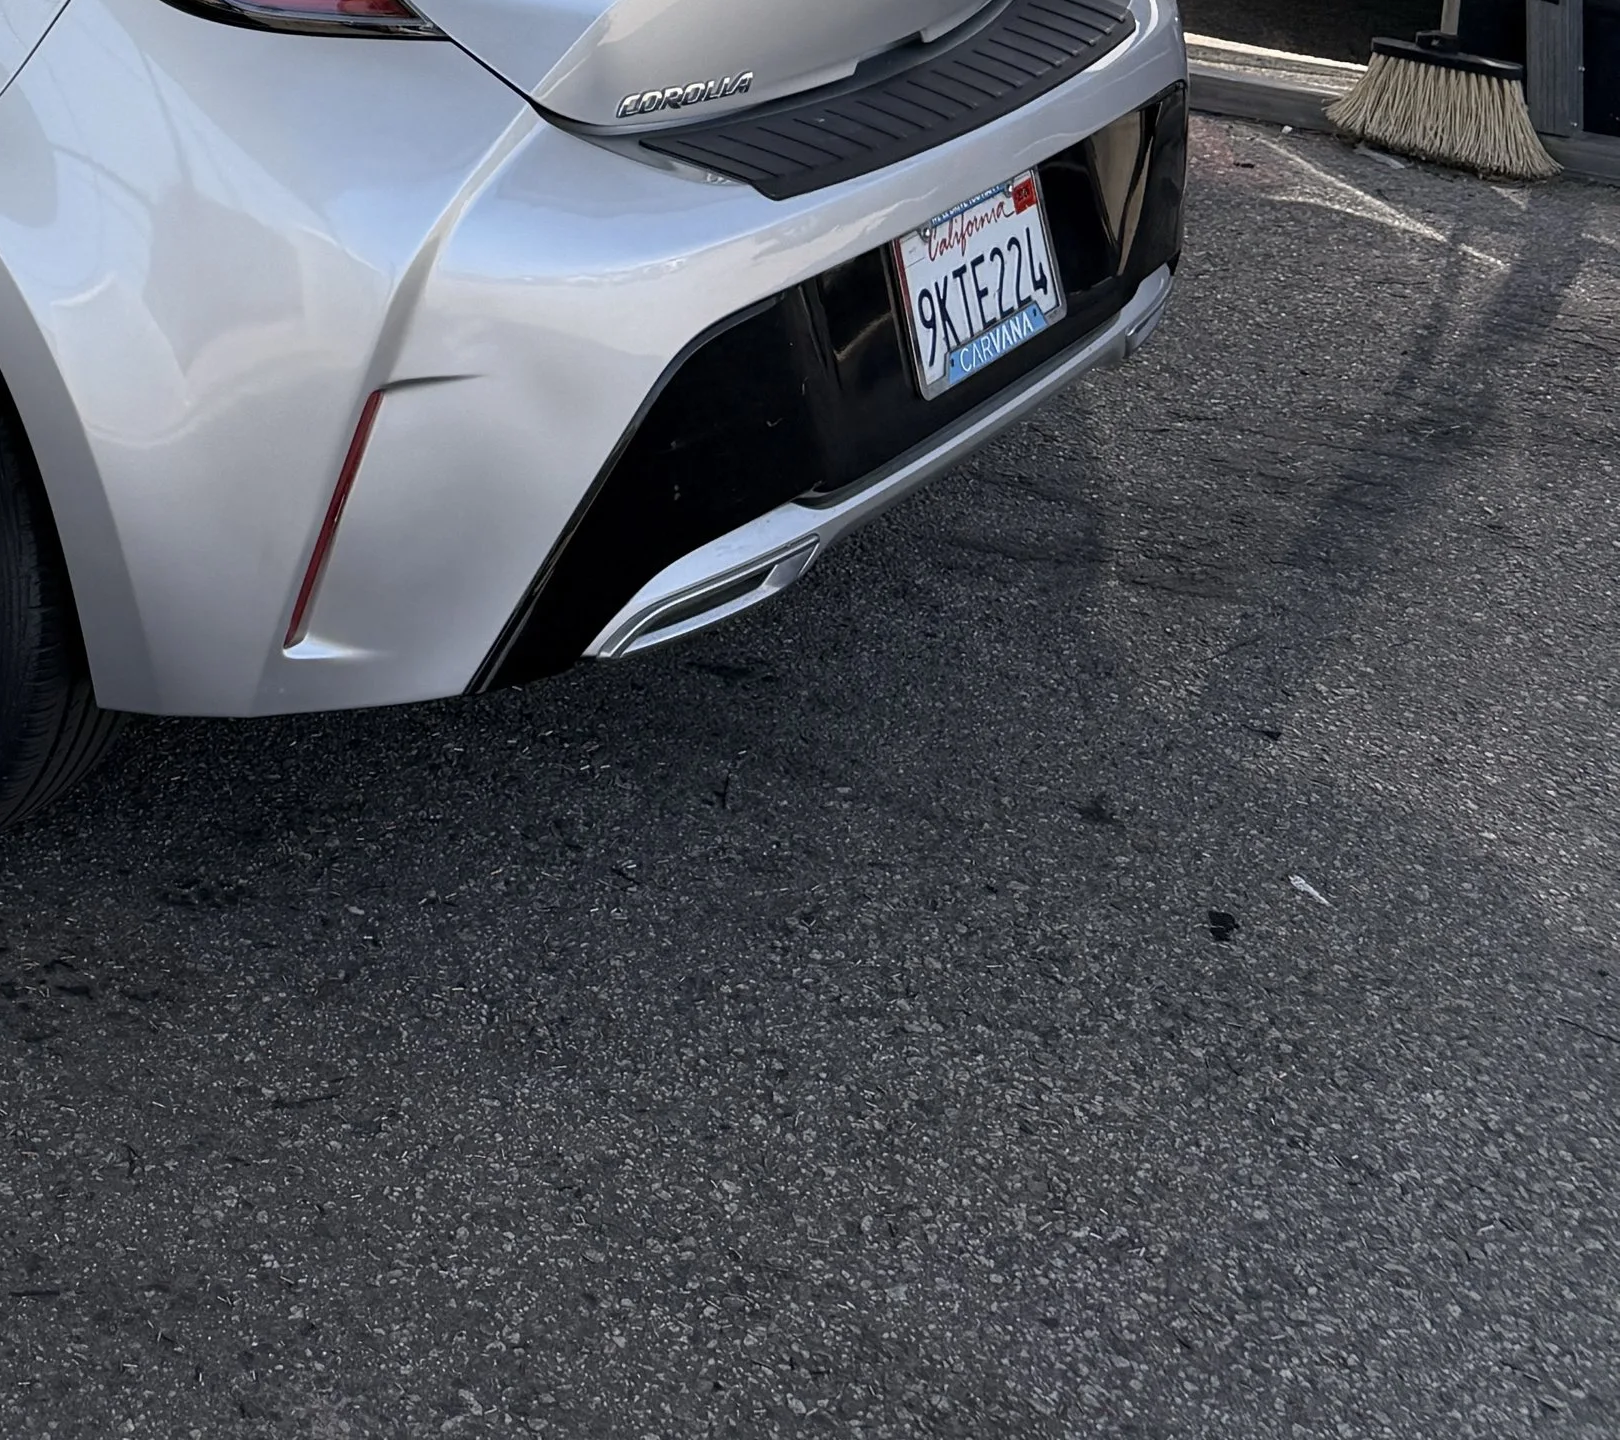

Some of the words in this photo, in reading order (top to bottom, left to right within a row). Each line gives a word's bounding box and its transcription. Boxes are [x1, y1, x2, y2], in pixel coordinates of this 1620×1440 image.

[616, 70, 754, 118] COROLLA
[928, 200, 1015, 262] California
[917, 226, 1048, 368] 9KTE224
[959, 311, 1035, 372] CARVANA
